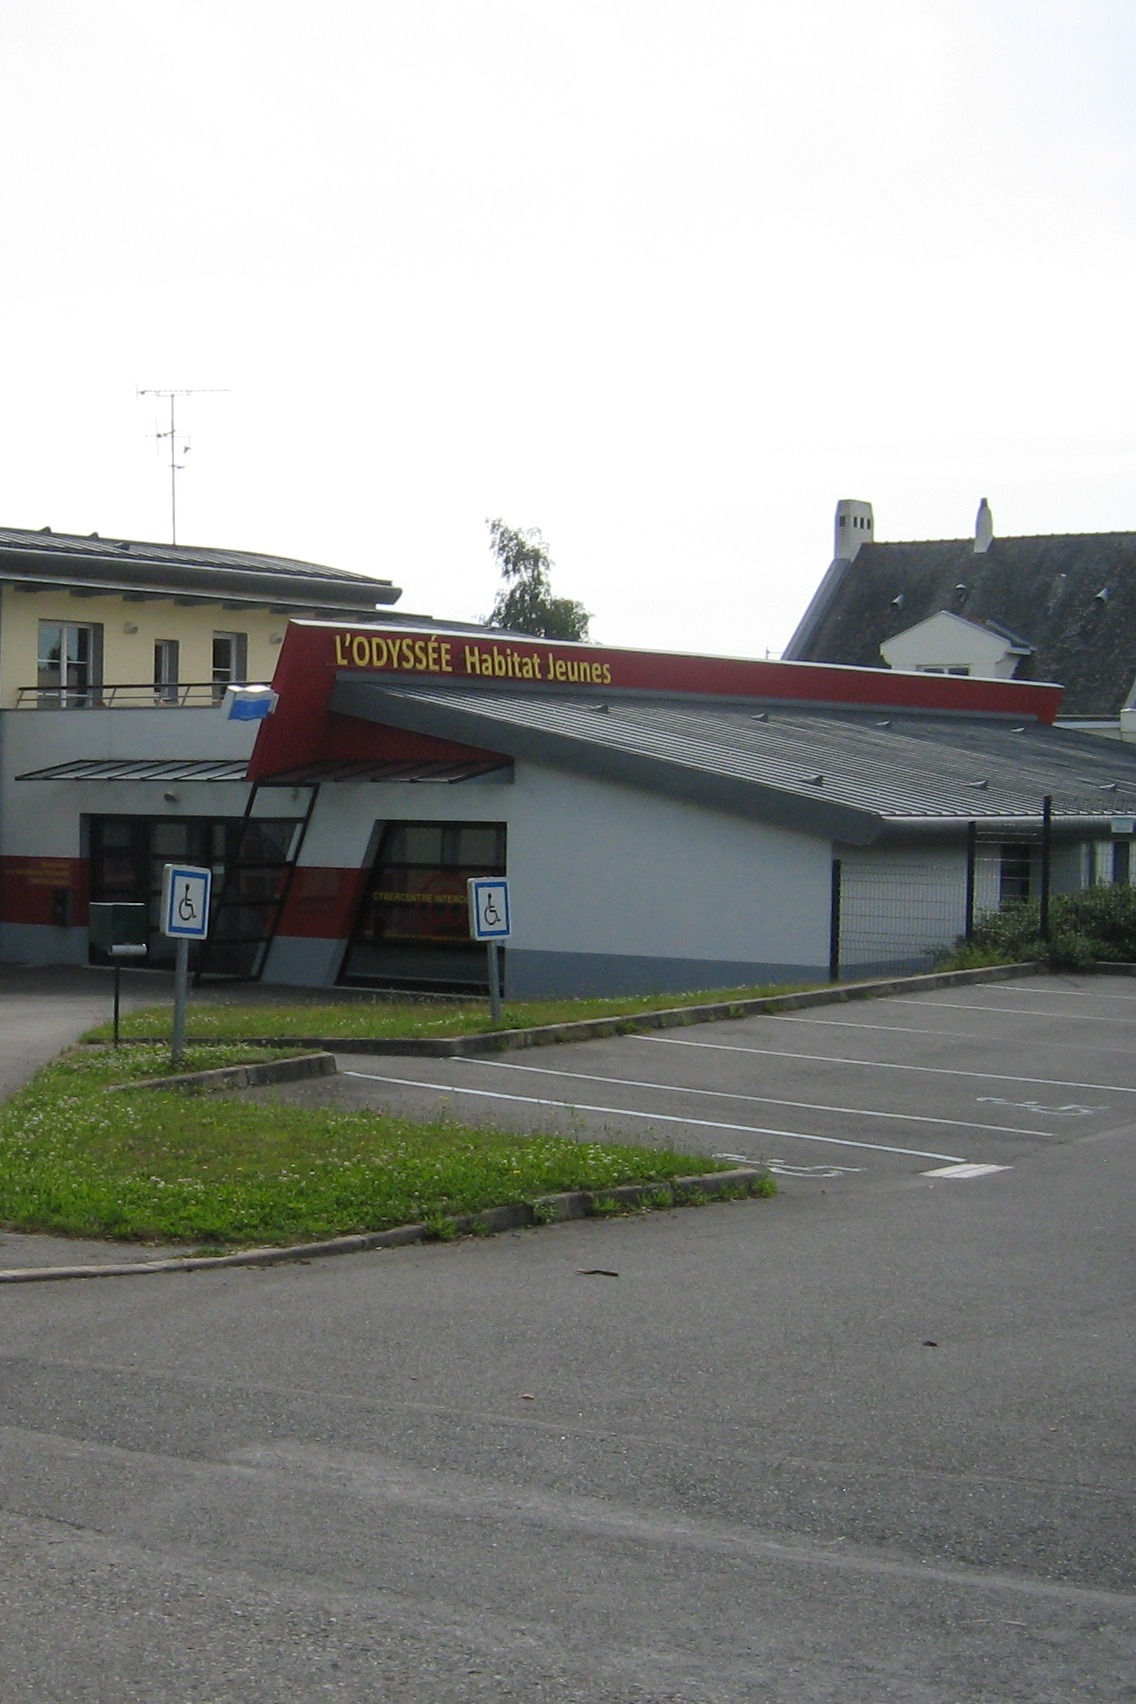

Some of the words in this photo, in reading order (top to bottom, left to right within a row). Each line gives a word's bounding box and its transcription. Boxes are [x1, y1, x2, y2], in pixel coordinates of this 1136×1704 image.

[335, 633, 453, 672] L'ODYSSÉE
[465, 645, 542, 680] Habitat
[547, 652, 612, 685] Jeunes
